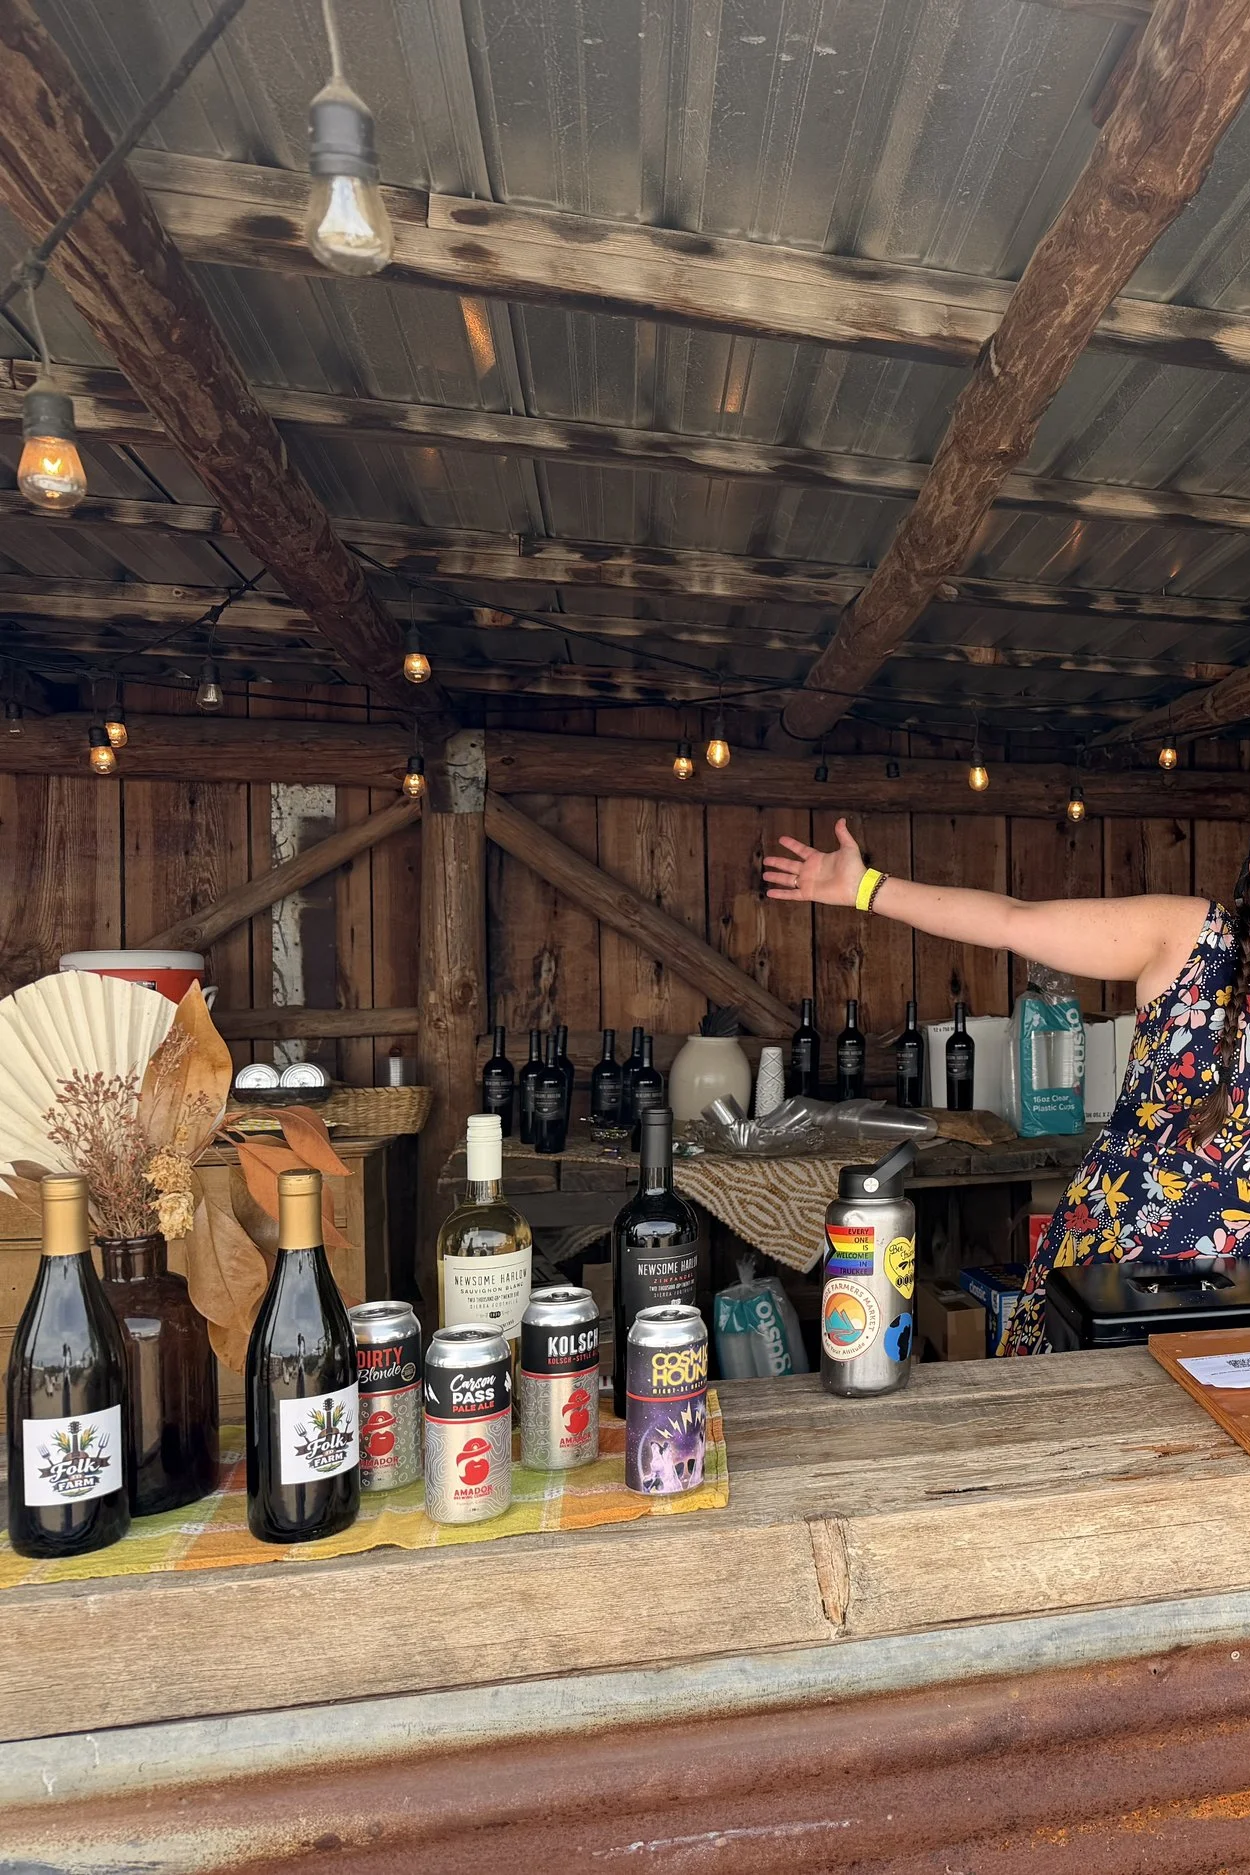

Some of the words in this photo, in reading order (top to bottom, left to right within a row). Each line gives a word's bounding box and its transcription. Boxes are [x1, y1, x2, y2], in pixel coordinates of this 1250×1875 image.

[1051, 1094, 1069, 1102] Clear
[1032, 1104, 1057, 1112] Plastic
[637, 1261, 679, 1276] NEWSOME
[454, 1274, 495, 1286] NEWSOME
[500, 1268, 528, 1284] HARLOW
[653, 1273, 694, 1284] ZINFANDEL
[460, 1287, 503, 1295] SAUVIGNON
[505, 1281, 524, 1291] BLANC
[831, 1283, 864, 1298] FARMERS
[863, 1297, 877, 1332] MARKET
[547, 1328, 599, 1358] KOLSCH
[755, 1300, 792, 1377] gusto
[842, 1342, 866, 1355] Altitude
[356, 1346, 403, 1369] DIRTY
[358, 1362, 401, 1384] Blonde
[450, 1373, 497, 1392] Carson
[452, 1387, 495, 1405] PASS
[452, 1404, 477, 1413] PALE
[477, 1400, 495, 1411] ALE
[306, 1434, 347, 1459] Folk
[314, 1452, 344, 1467] FARM
[49, 1457, 101, 1483] Folk
[58, 1478, 95, 1492] FARM
[454, 1485, 493, 1497] AMADOR
